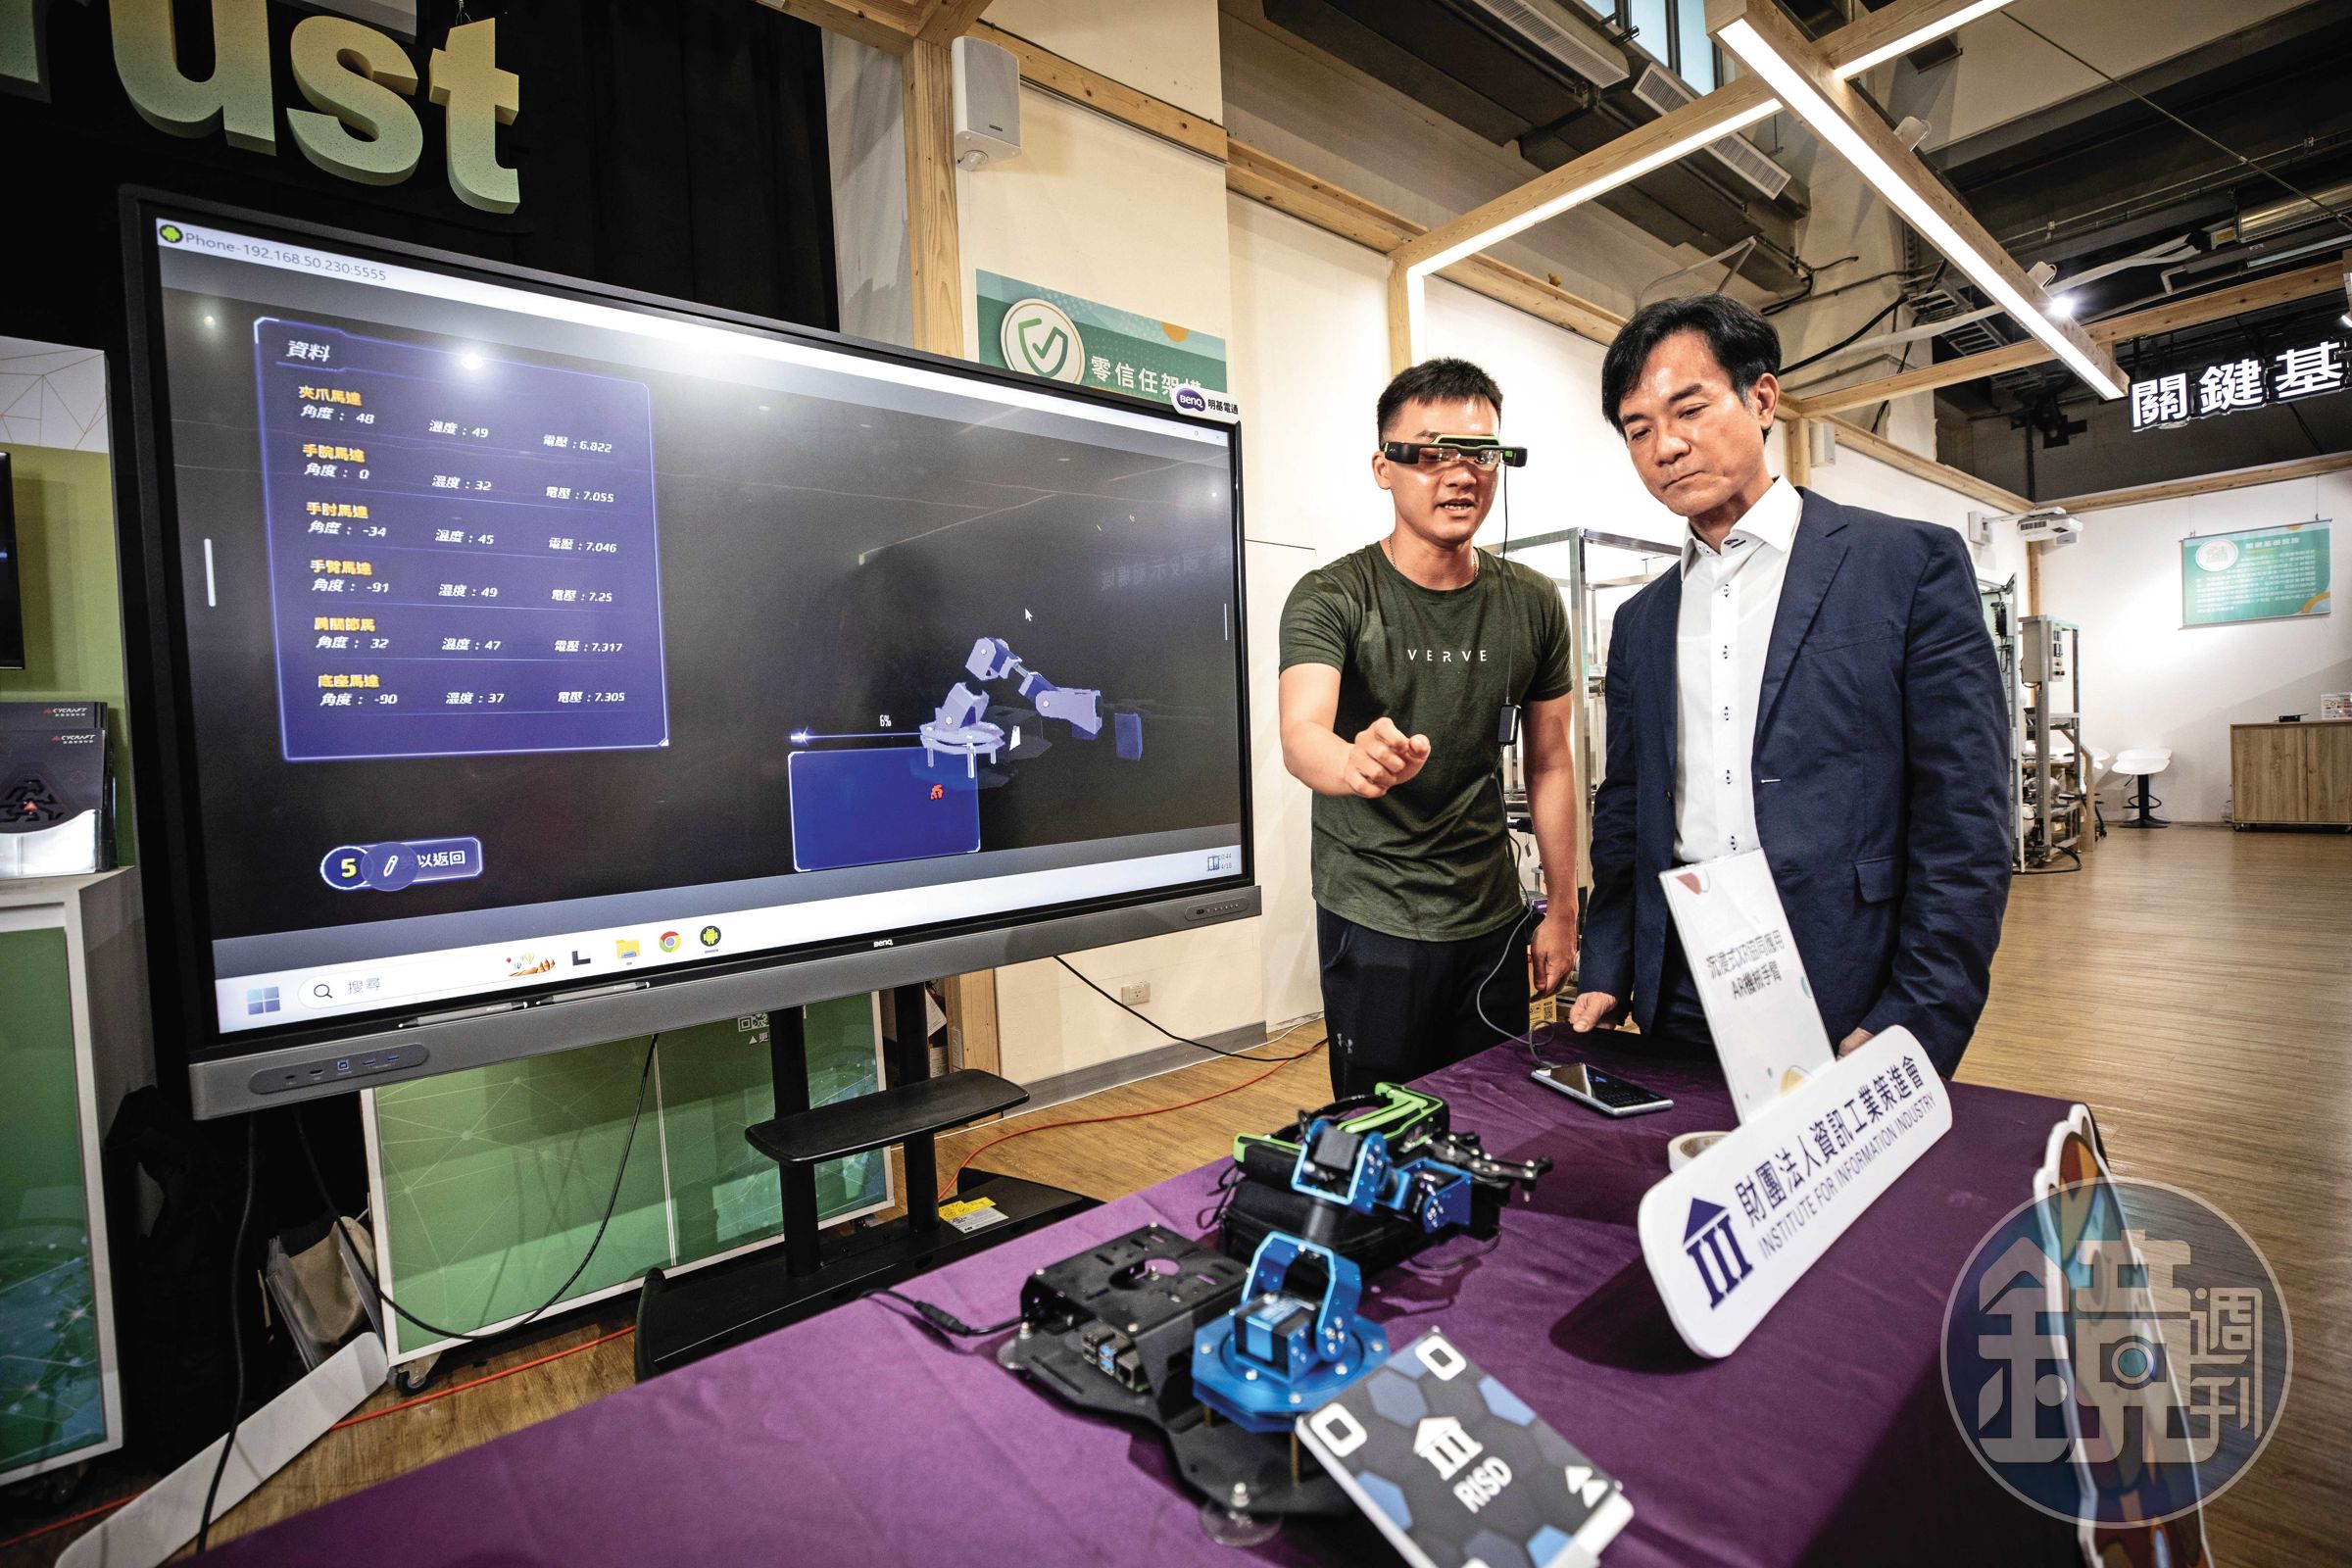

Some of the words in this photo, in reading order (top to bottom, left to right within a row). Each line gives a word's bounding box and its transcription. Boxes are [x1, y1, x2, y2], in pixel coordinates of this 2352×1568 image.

[0, 0, 519, 214] ust
[186, 232, 386, 281] Phone-192.168.50.230:5555
[286, 340, 330, 363] 資料
[2132, 340, 2343, 427] 關鍵基
[298, 385, 362, 406] 夾爪馬達
[1179, 394, 1203, 409] BenQ
[1207, 399, 1239, 415] 明基電通
[356, 413, 375, 424] 48
[302, 443, 366, 463] 手腕馬達
[359, 468, 369, 479] 0
[369, 638, 390, 649] 32
[1407, 649, 1488, 662] VERVE
[318, 674, 380, 688] 底座馬達
[879, 714, 892, 727] 6%
[341, 858, 358, 878] 5
[400, 850, 466, 869] 以返回
[873, 939, 894, 948] BenQ
[347, 977, 381, 995] 搜尋
[1735, 1054, 1924, 1228] 財團法人資訊工業策進會
[1758, 1194, 1818, 1259] INSTITUTE
[1815, 1178, 1838, 1207] FOR
[1838, 1126, 1898, 1191] INFORMATION
[1895, 1091, 1937, 1137] INDUSTRY
[1452, 1456, 1512, 1513] RISD
